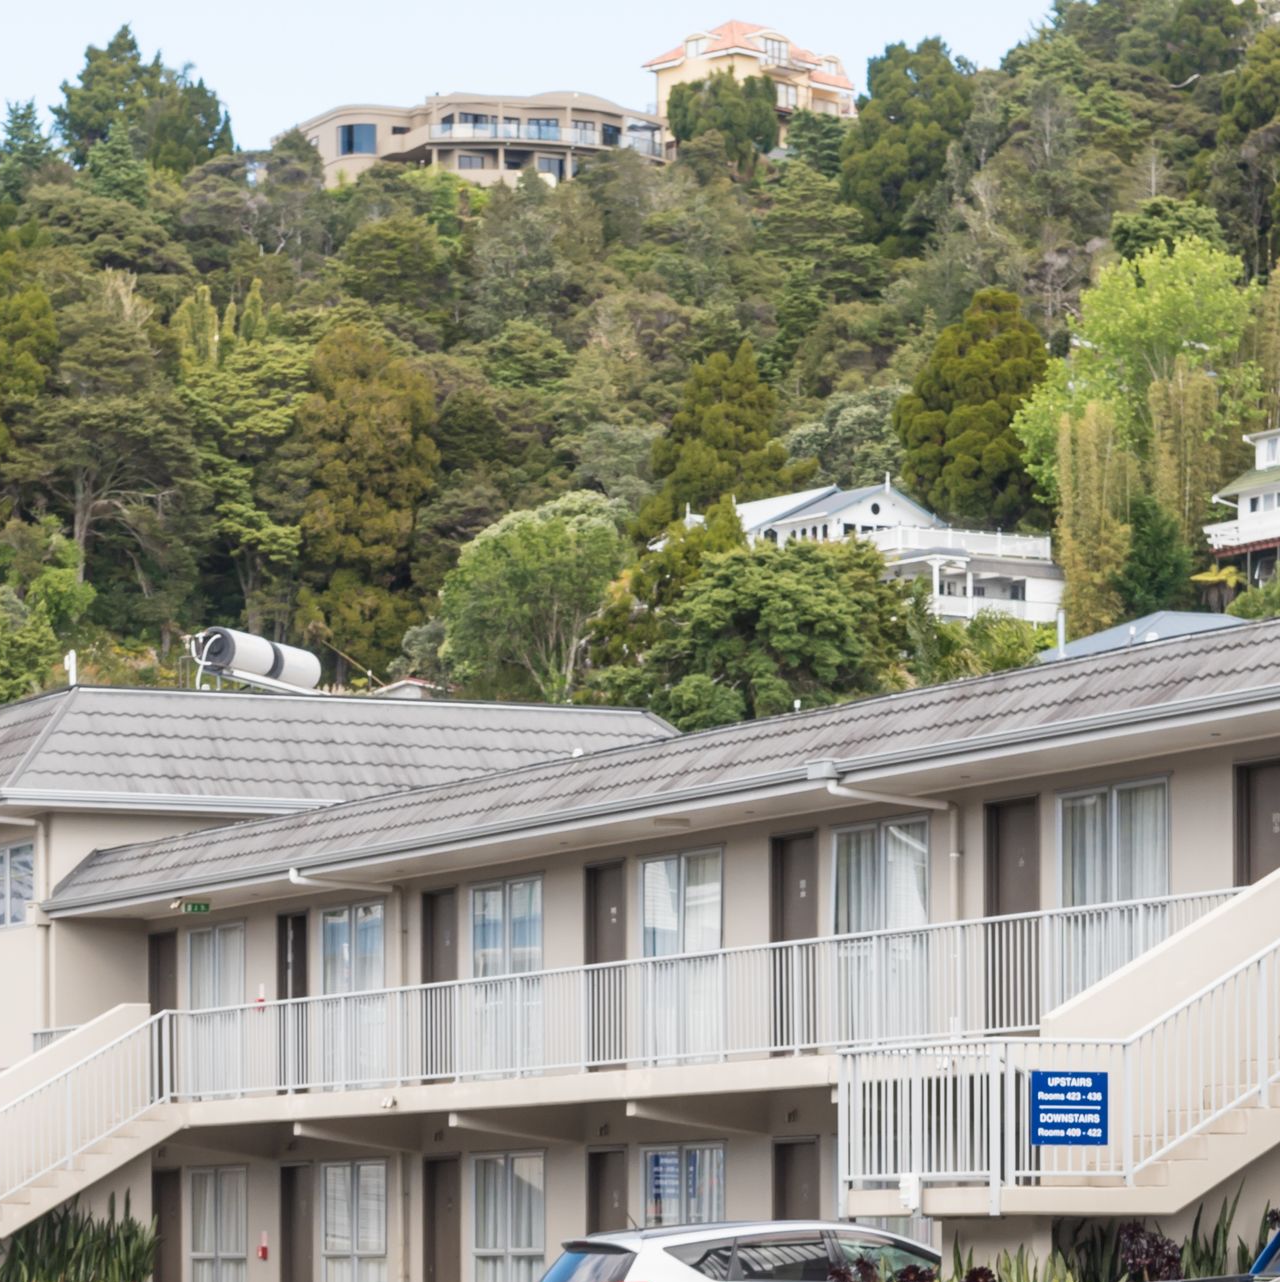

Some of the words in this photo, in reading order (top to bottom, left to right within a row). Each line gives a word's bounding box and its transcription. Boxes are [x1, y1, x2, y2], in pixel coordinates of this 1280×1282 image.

[1047, 1077, 1092, 1087] UPSTAIRS
[1038, 1091, 1065, 1101] Rooms
[1040, 1113, 1100, 1123] DOWNSTAIRS
[1038, 1127, 1065, 1137] Rooms
